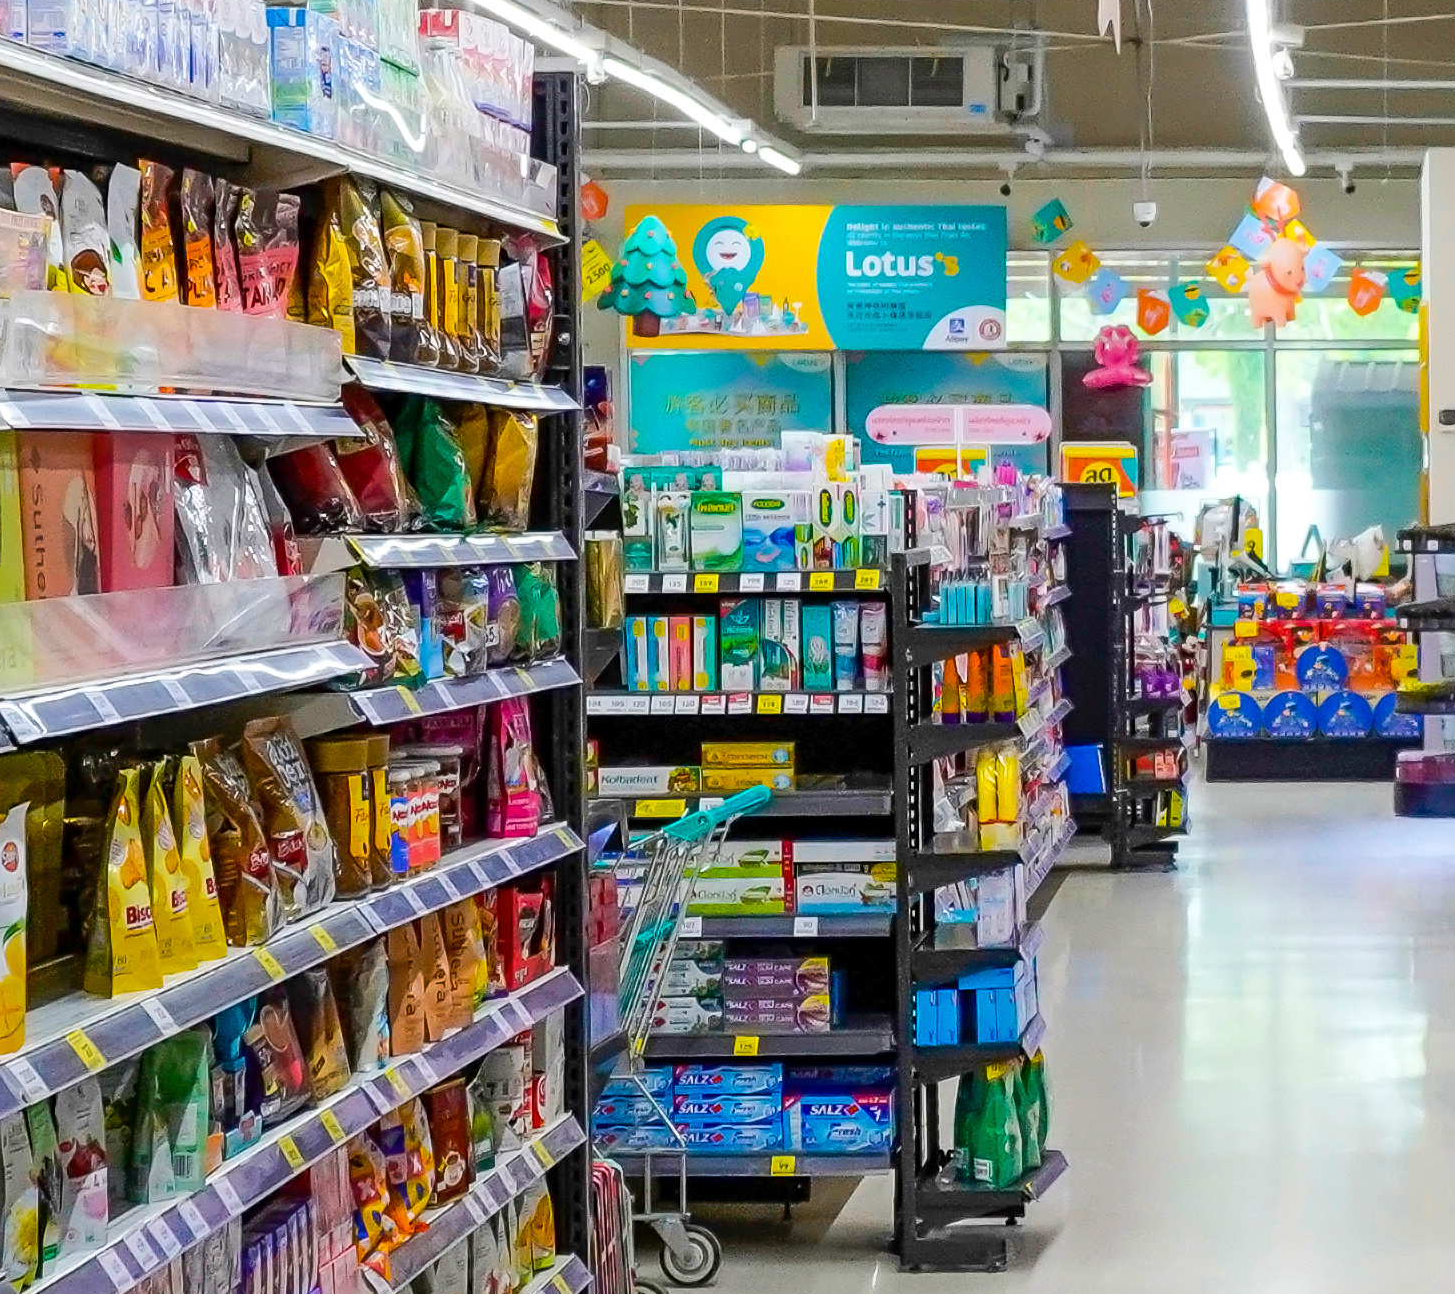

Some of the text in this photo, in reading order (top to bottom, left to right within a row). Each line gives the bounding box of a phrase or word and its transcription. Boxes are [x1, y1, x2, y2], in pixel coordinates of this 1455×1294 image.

[846, 251, 959, 278] Lotus's
[679, 1076, 710, 1085] SALZ
[679, 1104, 710, 1114] SALZ
[810, 1104, 843, 1115] SALZ
